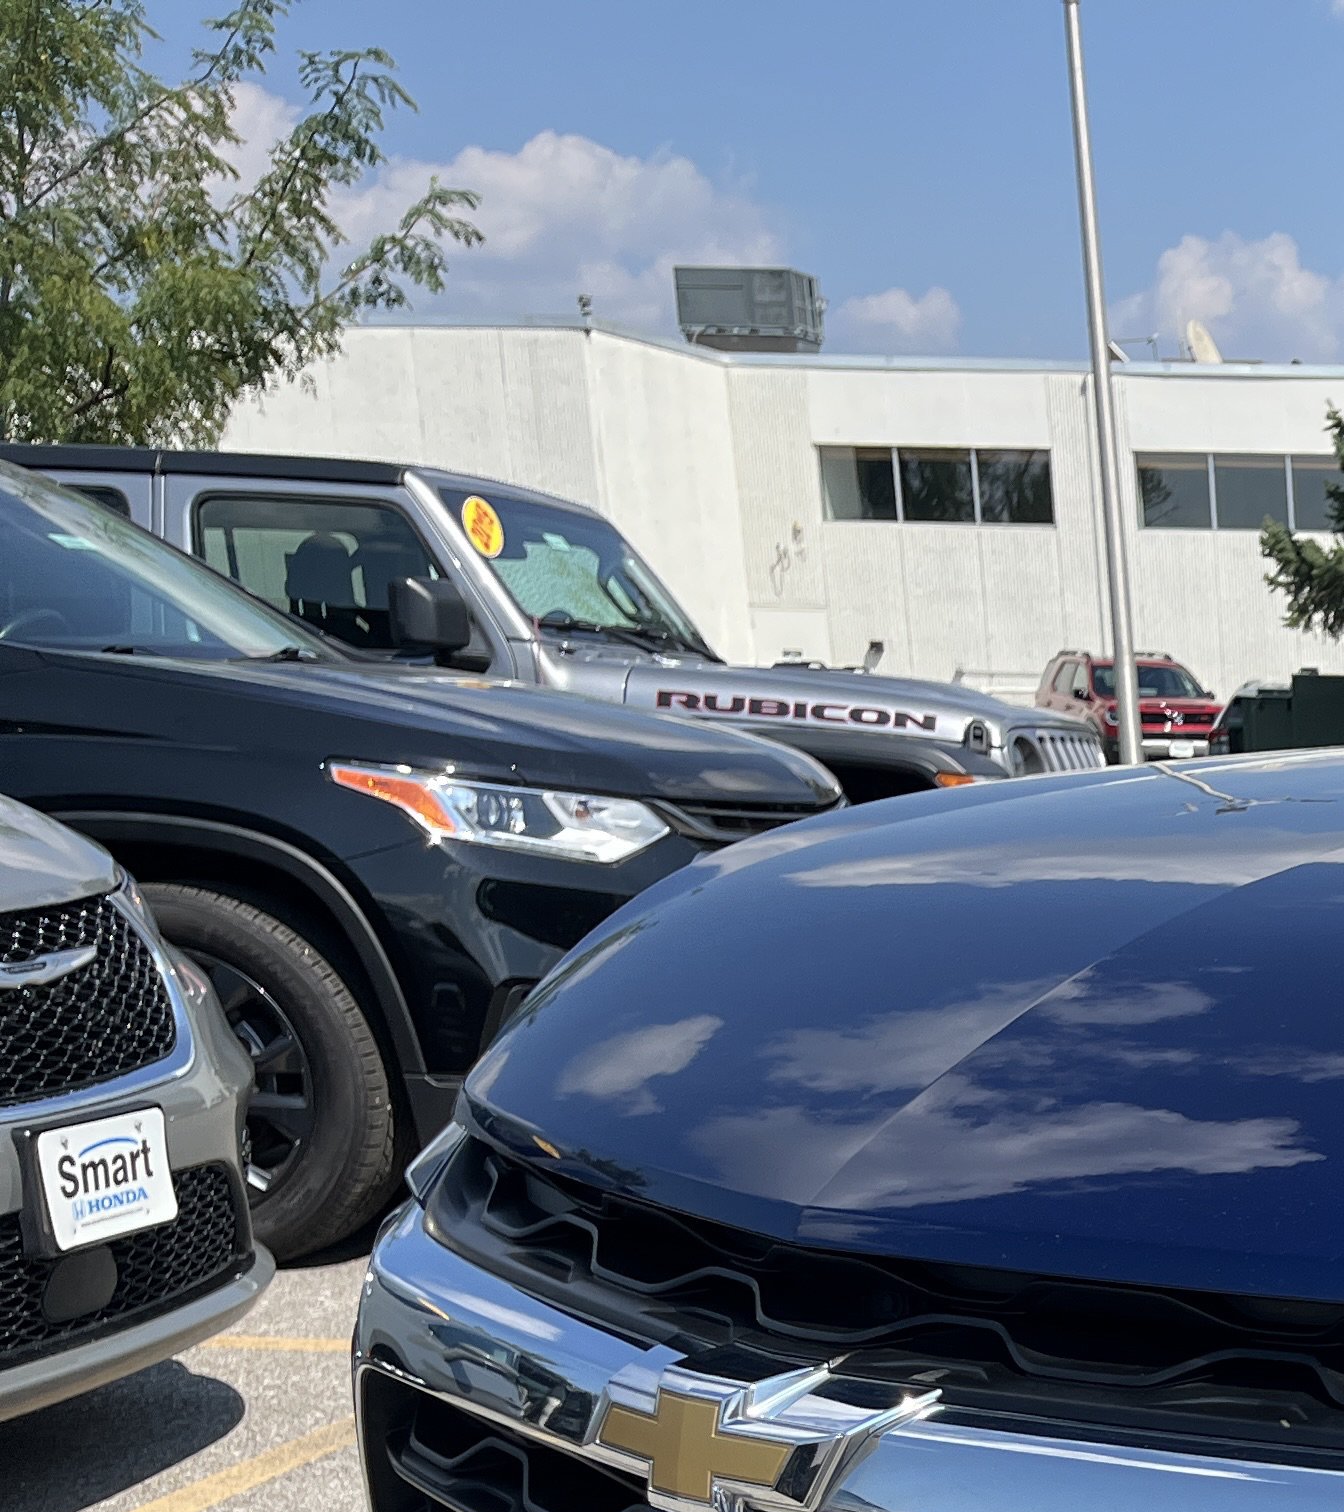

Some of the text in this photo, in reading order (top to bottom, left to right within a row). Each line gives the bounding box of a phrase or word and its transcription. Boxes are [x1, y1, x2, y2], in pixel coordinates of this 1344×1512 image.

[656, 689, 937, 731] RUBICON
[57, 1139, 153, 1199] Smart
[87, 1187, 148, 1214] HONDA
